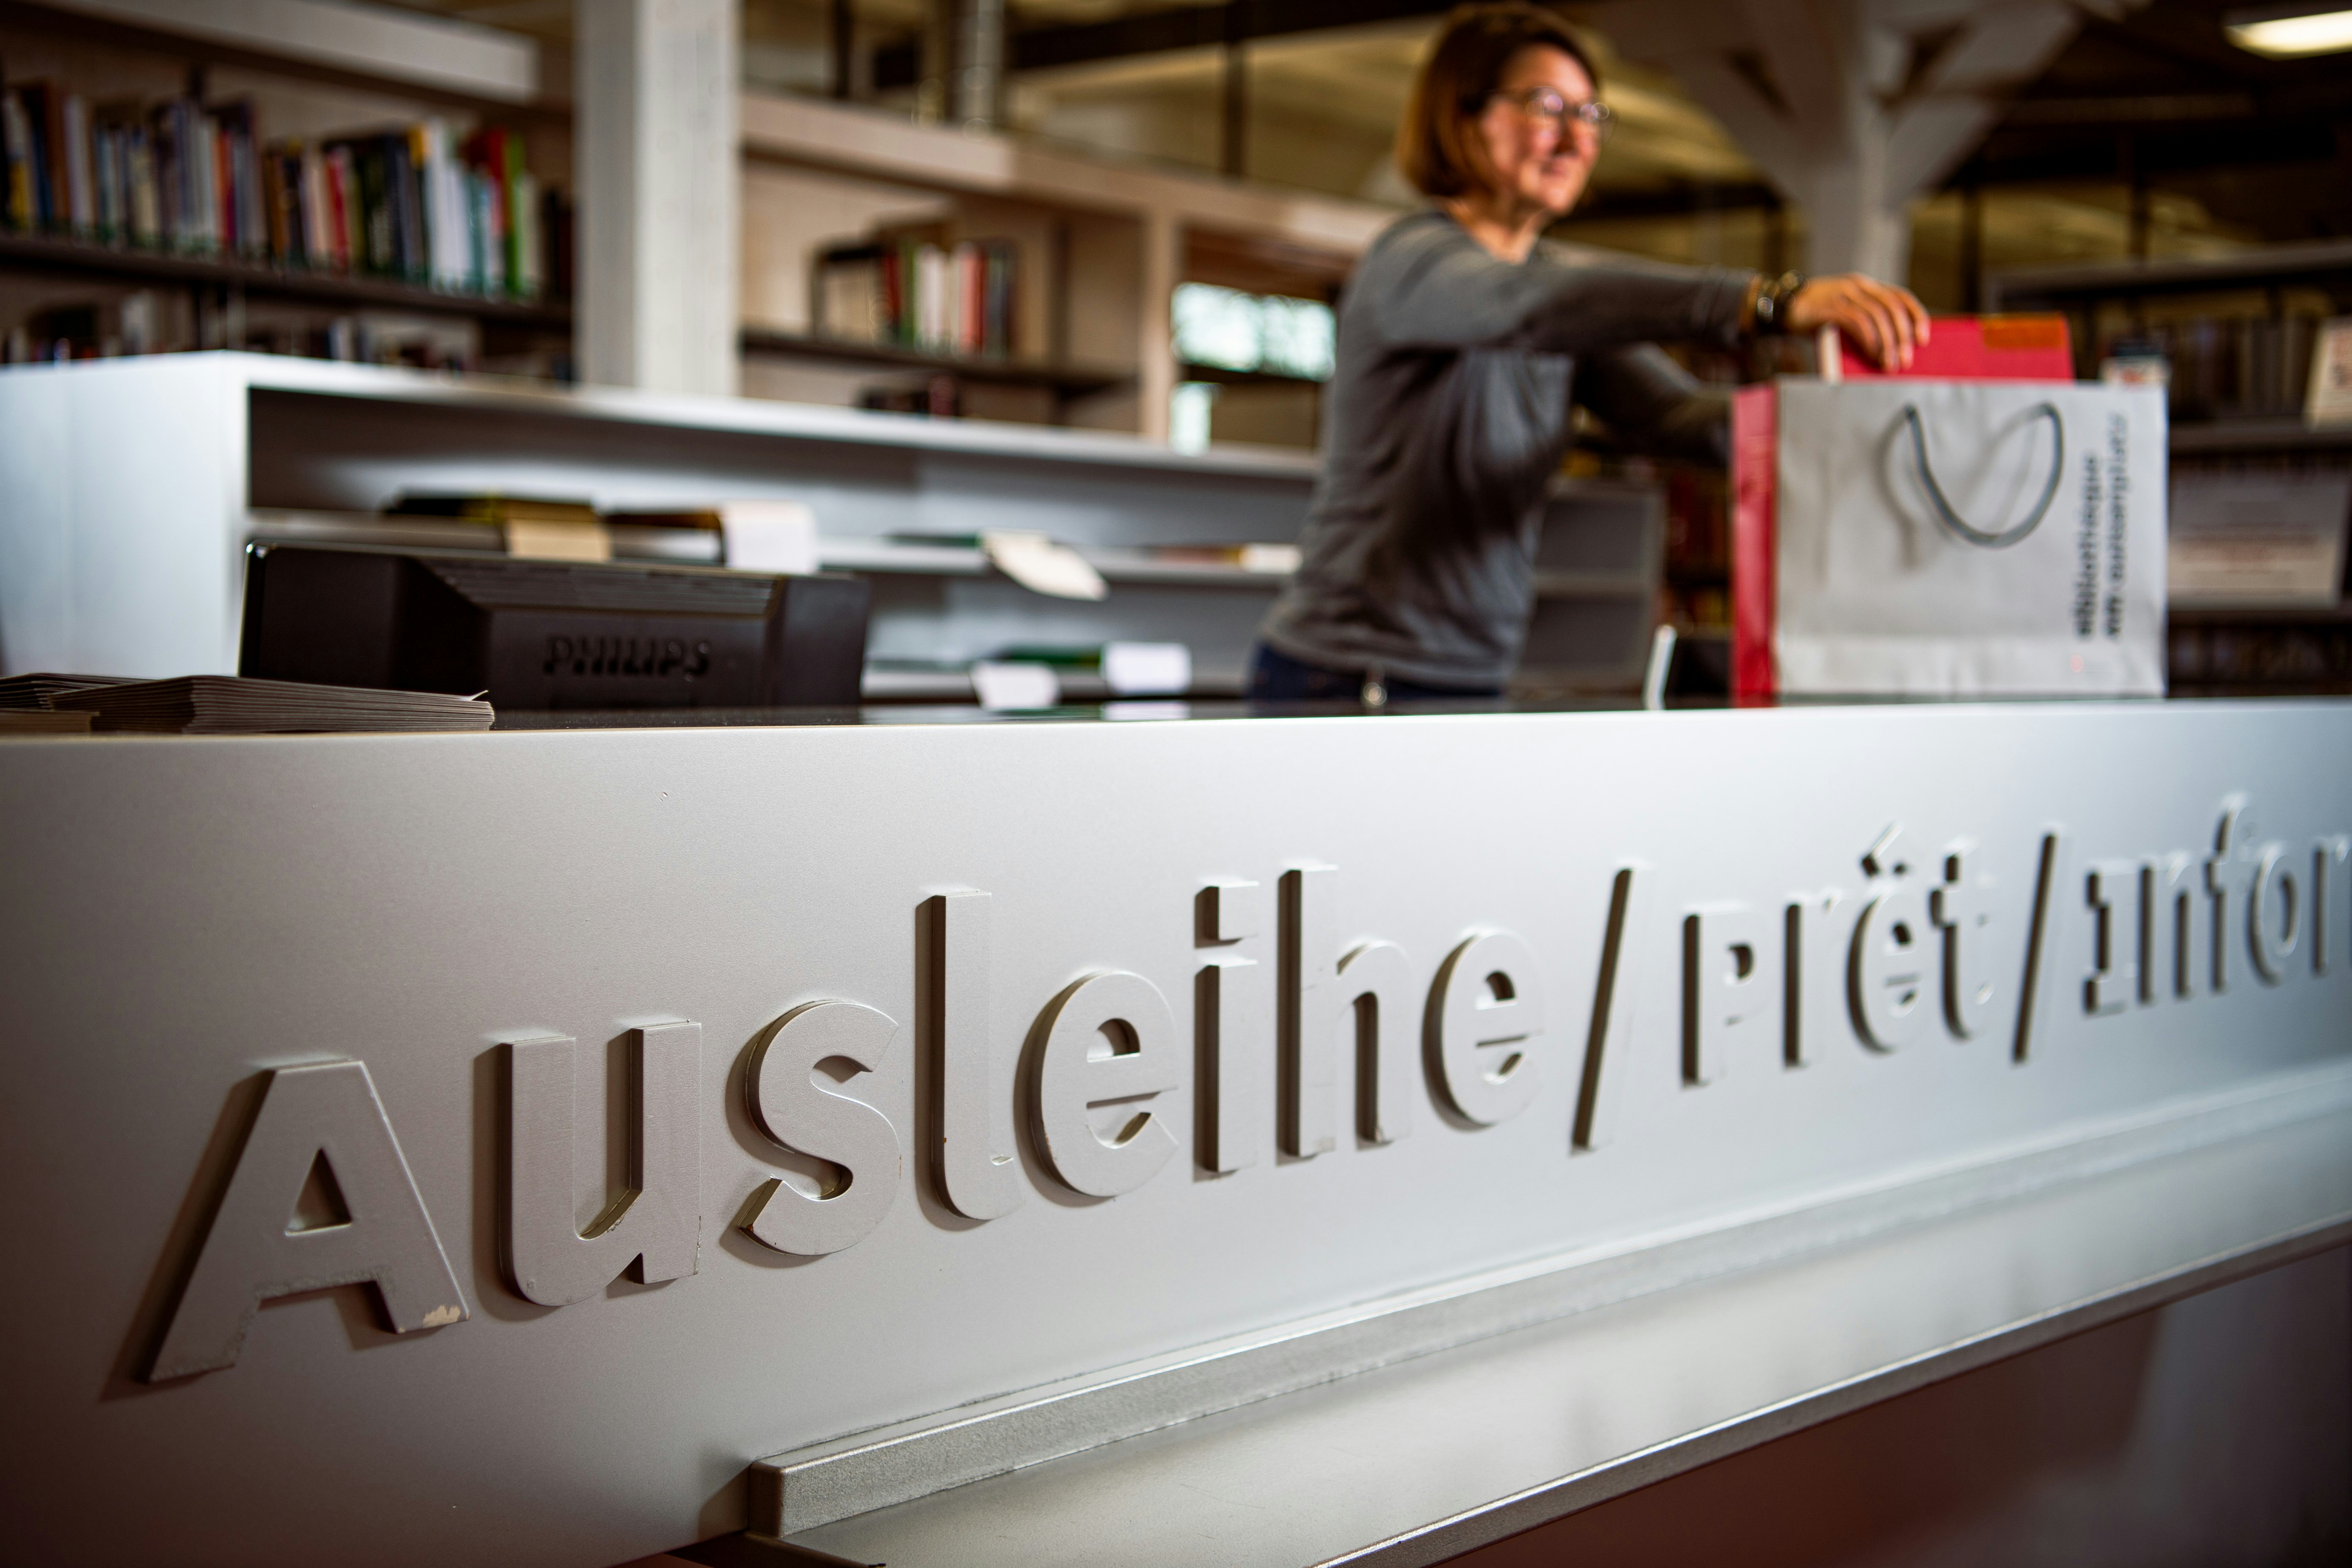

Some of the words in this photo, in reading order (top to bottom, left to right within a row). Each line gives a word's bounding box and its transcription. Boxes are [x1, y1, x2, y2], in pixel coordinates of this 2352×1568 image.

[544, 635, 710, 677] PHILIPS
[142, 862, 1545, 1386] Ausleihe
[1681, 822, 1994, 1089] Prêt
[2082, 790, 2352, 1017] Infor
